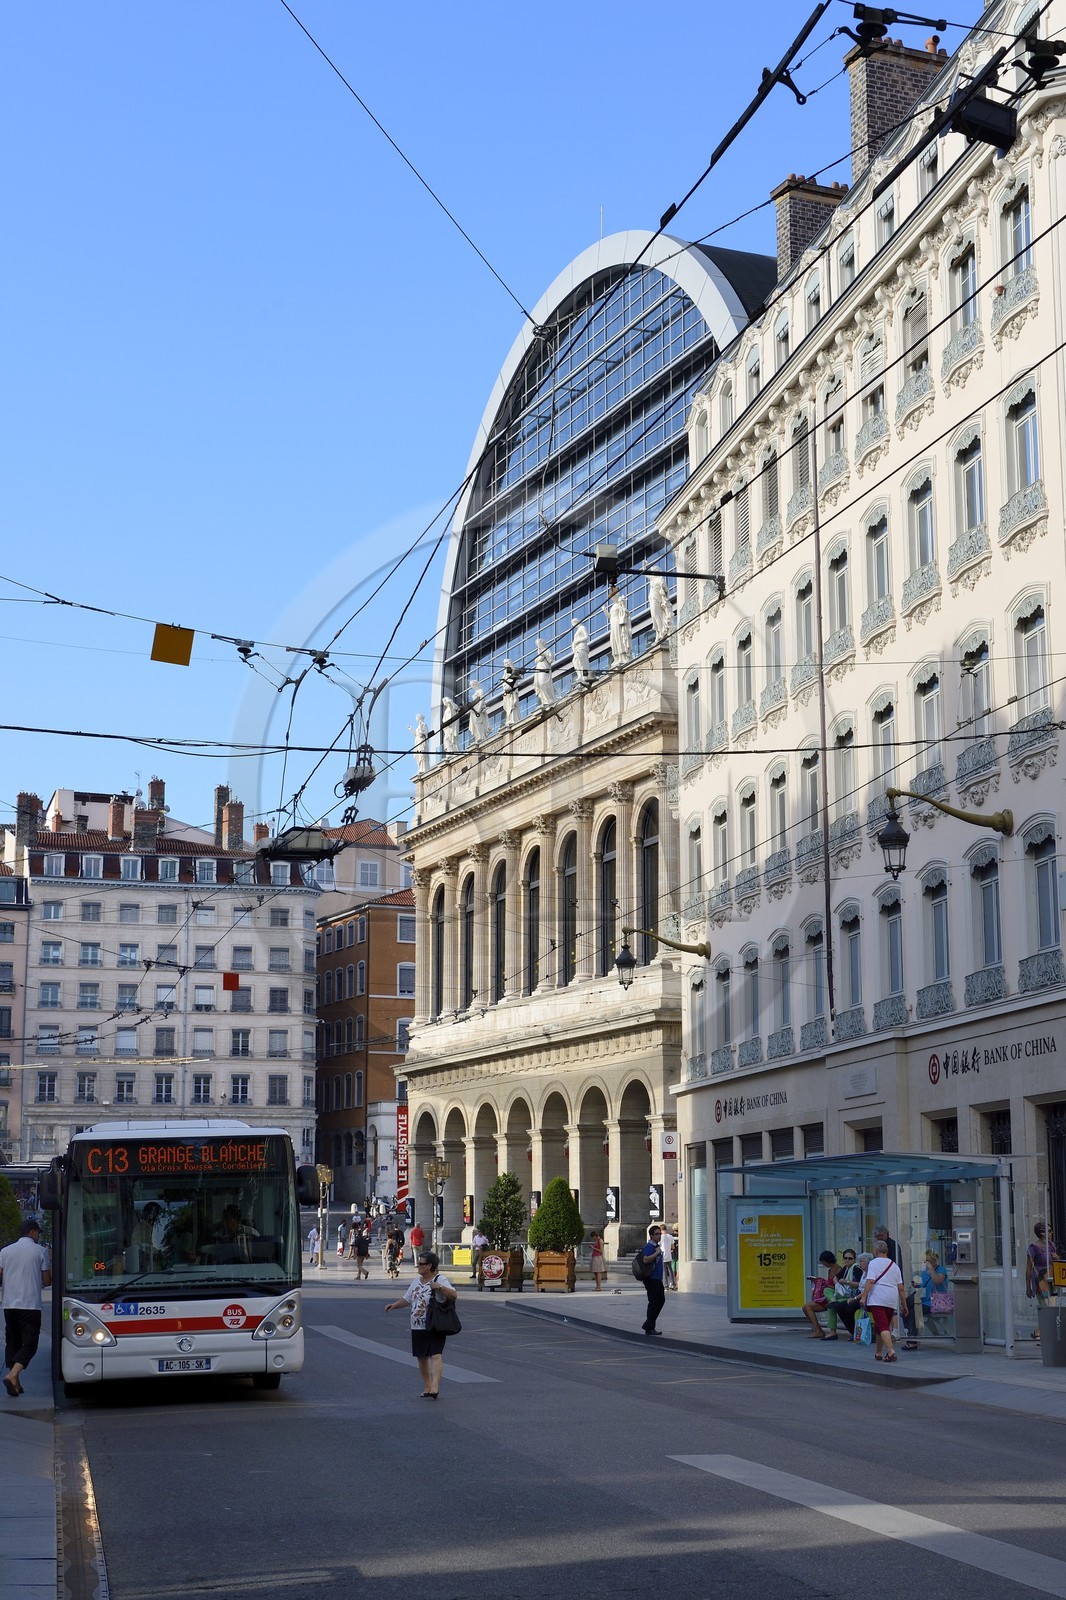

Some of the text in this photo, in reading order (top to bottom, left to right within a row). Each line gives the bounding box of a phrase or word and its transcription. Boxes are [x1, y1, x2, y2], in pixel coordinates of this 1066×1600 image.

[984, 1036, 1057, 1065] BANK OF CHINA
[747, 1091, 788, 1110] BANK OF CHINA
[139, 1144, 266, 1164] GRANGE BLANCHE
[399, 1113, 408, 1181] LE PERISTYLE
[87, 1147, 130, 1174] C13
[141, 1164, 156, 1172] via
[158, 1163, 181, 1172] Croix
[222, 1162, 267, 1170] Cordeliers
[139, 1305, 166, 1315] 2635
